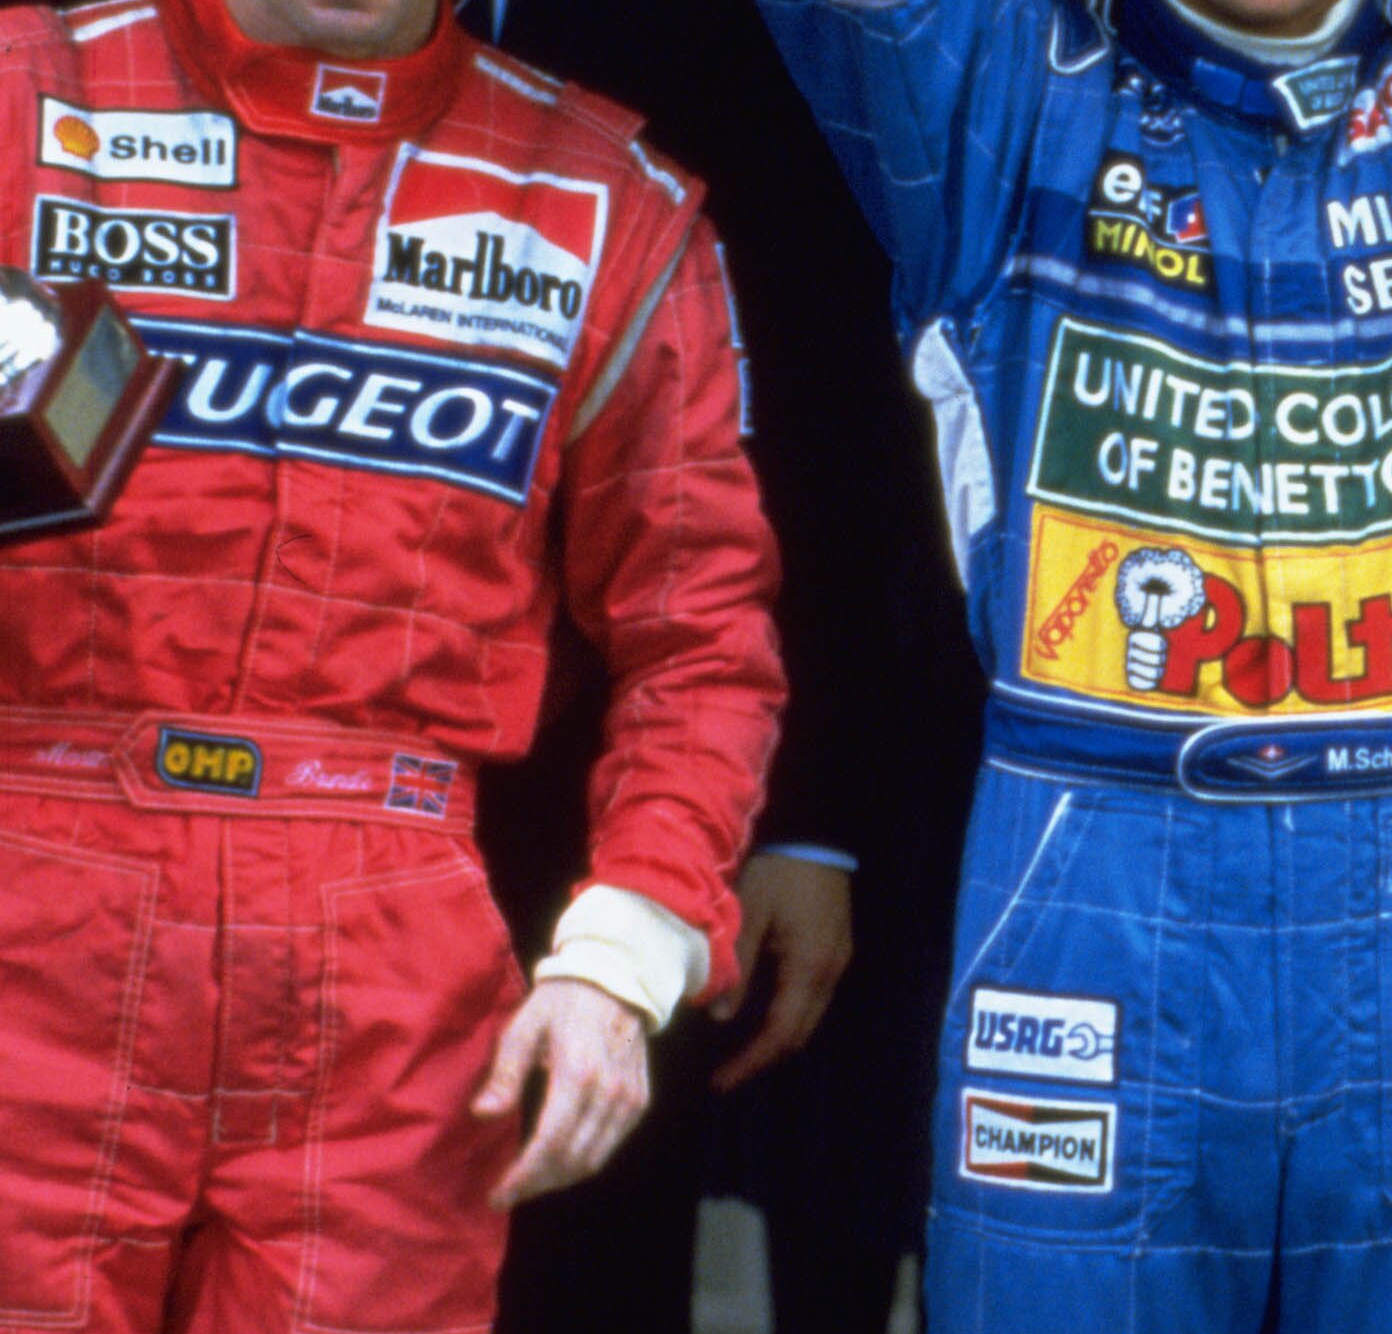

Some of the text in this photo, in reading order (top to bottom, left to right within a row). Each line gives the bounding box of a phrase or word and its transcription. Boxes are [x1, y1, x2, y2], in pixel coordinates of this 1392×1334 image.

[109, 134, 226, 166] Shell
[49, 208, 219, 269] BOSS
[1094, 219, 1206, 284] MINOL
[382, 231, 583, 320] Marlboro
[376, 297, 454, 322] McLAREN
[148, 349, 540, 462] UGEOT
[1073, 352, 1256, 440] UNITED
[1098, 432, 1159, 491] OF
[164, 742, 254, 781] OMP
[975, 1010, 1065, 1057] USAG
[975, 1124, 1096, 1162] CHAMPION
